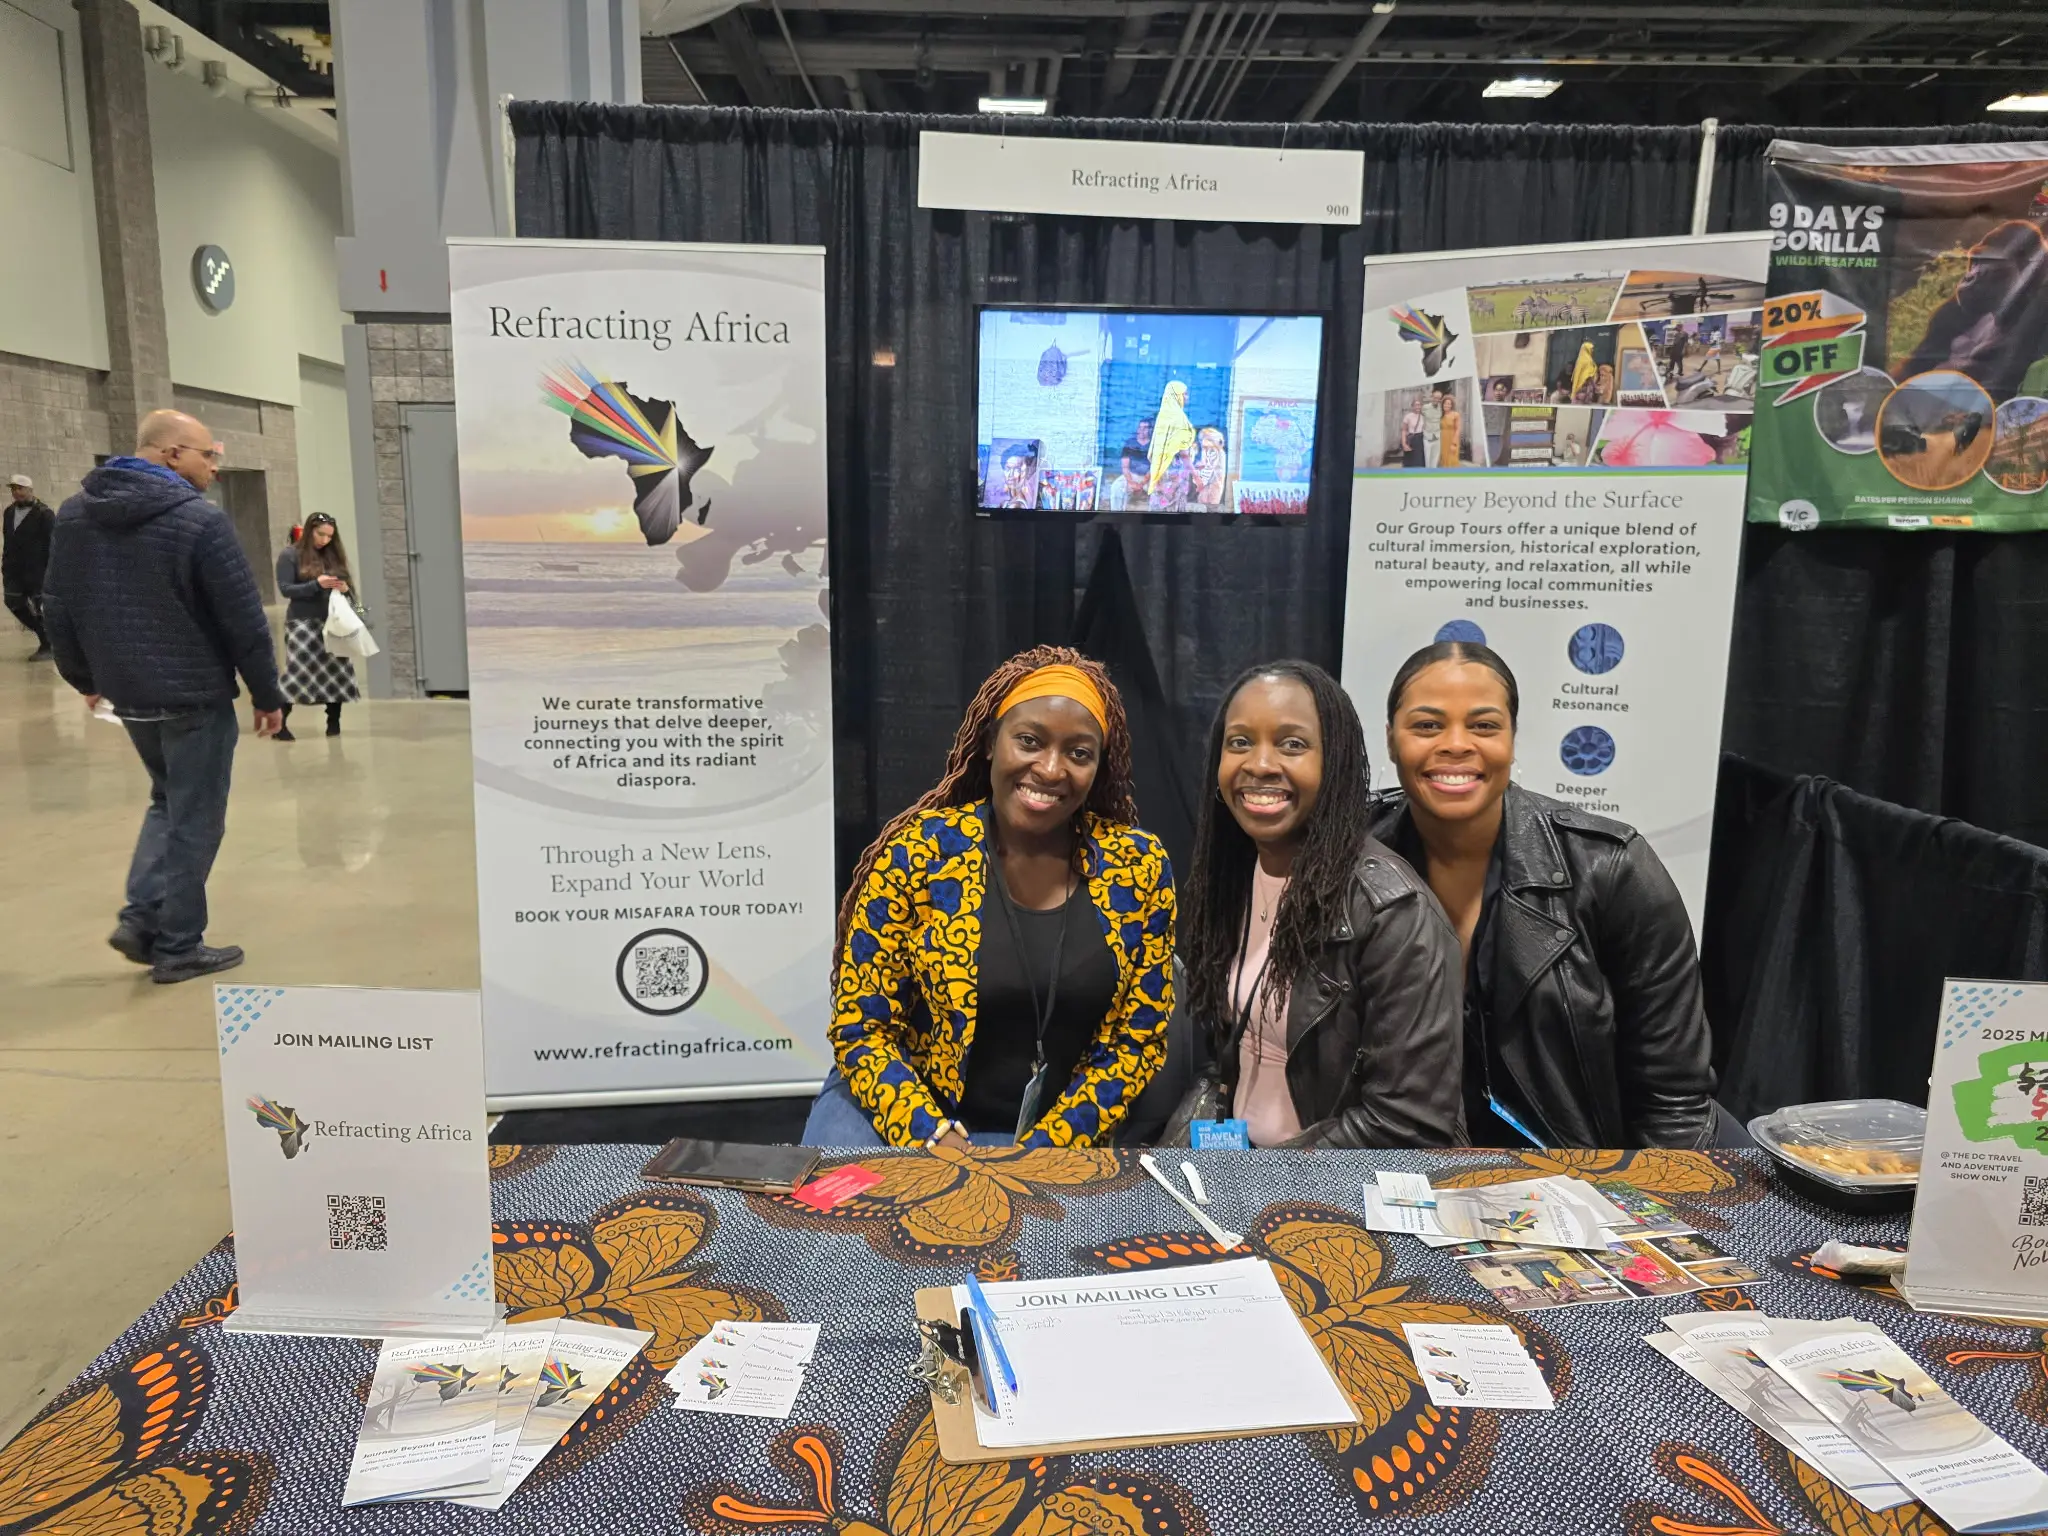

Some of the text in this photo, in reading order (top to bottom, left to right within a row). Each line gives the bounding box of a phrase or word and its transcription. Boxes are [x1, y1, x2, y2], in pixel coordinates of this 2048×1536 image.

[1071, 169, 1218, 193] Refracting Africa
[1326, 204, 1350, 218] 900
[1769, 202, 1886, 231] 9 DAYS
[1771, 231, 1881, 253] GORILLA
[1767, 299, 1823, 328] 20%
[489, 306, 791, 351] Refracting Africa
[1773, 343, 1839, 376] OFF
[1399, 489, 1684, 513] Journey Beyond the Surface
[1898, 496, 1933, 504] PERSON
[1784, 509, 1809, 522] T/C
[1376, 521, 1698, 539] Our Group Tours offer a unique blend of
[1368, 539, 1701, 558] cultural immersion, historical exploration,
[1374, 557, 1692, 575] natural beauty, and relaxation, all while
[1405, 576, 1653, 593] empowering local communities
[1465, 593, 1589, 610] and businesses.
[1561, 682, 1620, 696] Cultural
[542, 695, 764, 710] We curate transformative
[1552, 698, 1629, 712] Resonance
[533, 715, 773, 733] journeys that delve deeper,
[524, 733, 784, 752] connecting you with the spirit
[553, 753, 757, 769] of Africa and its radiant
[617, 773, 696, 789] diaspora.
[1555, 782, 1608, 797] Deeper
[1567, 799, 1620, 812] ersion
[540, 842, 772, 868] Through a New Lens,
[551, 868, 765, 898] Expand Your World
[515, 902, 804, 923] BOOK YOUR MISAFARA TOUR TODAY!
[273, 1033, 434, 1051] JOIN MAILING LIST
[1981, 1029, 2026, 1042] 2025
[534, 1037, 793, 1063] www.refractingafrica.com
[313, 1120, 473, 1143] Refracting Africa
[1940, 1151, 1950, 1159] @
[1952, 1152, 1970, 1160] THE
[1988, 1154, 2023, 1163] TRAVEL
[1950, 1172, 2008, 1182] SHOW ONLY
[1963, 1163, 2019, 1173] ADVENTURE
[1015, 1284, 1219, 1308] JOIN MAILING LIST
[508, 1338, 545, 1349] Africa
[1691, 1329, 1748, 1341] Refracting
[1748, 1328, 1771, 1337] Afri
[391, 1343, 455, 1358] Refracting
[551, 1338, 594, 1354] fracting
[595, 1346, 628, 1358] Africa
[1780, 1346, 1841, 1367] Refracting
[1840, 1338, 1876, 1352] Africa
[363, 1434, 487, 1460] Journey Beyond the Surface
[512, 1455, 535, 1463] urface
[1906, 1464, 1939, 1479] Journey
[1938, 1459, 1970, 1471] Beyond
[1970, 1456, 1984, 1465] the
[1984, 1451, 2015, 1462] Surface
